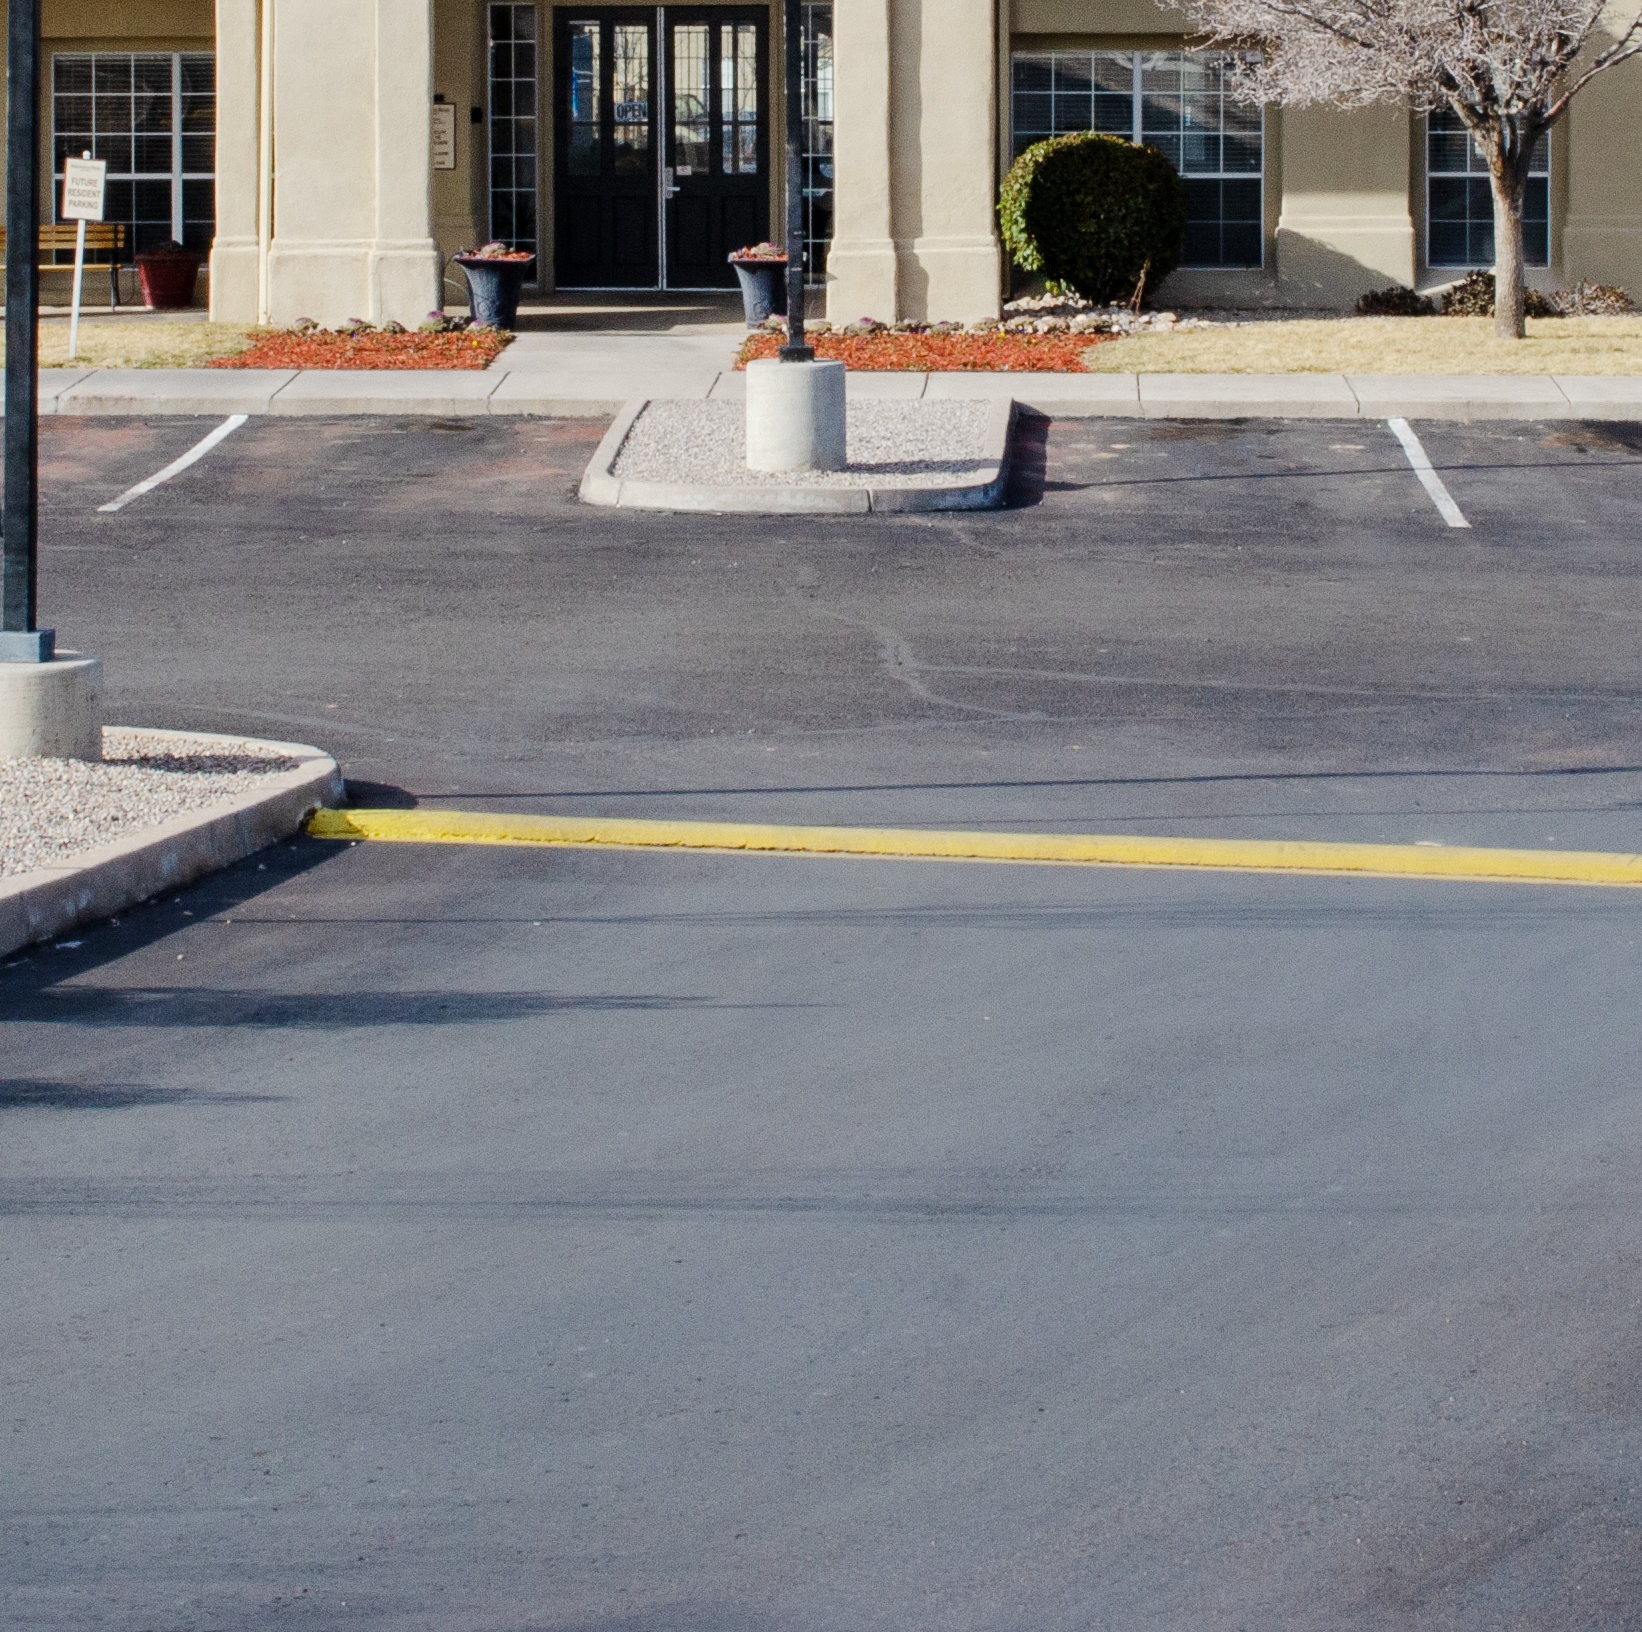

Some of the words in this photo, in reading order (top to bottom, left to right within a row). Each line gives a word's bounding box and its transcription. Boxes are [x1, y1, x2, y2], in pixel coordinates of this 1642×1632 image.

[617, 104, 647, 118] OPEN
[71, 177, 98, 187] FUTURE
[68, 188, 101, 198] RESIDENT
[68, 199, 99, 209] PARKING
